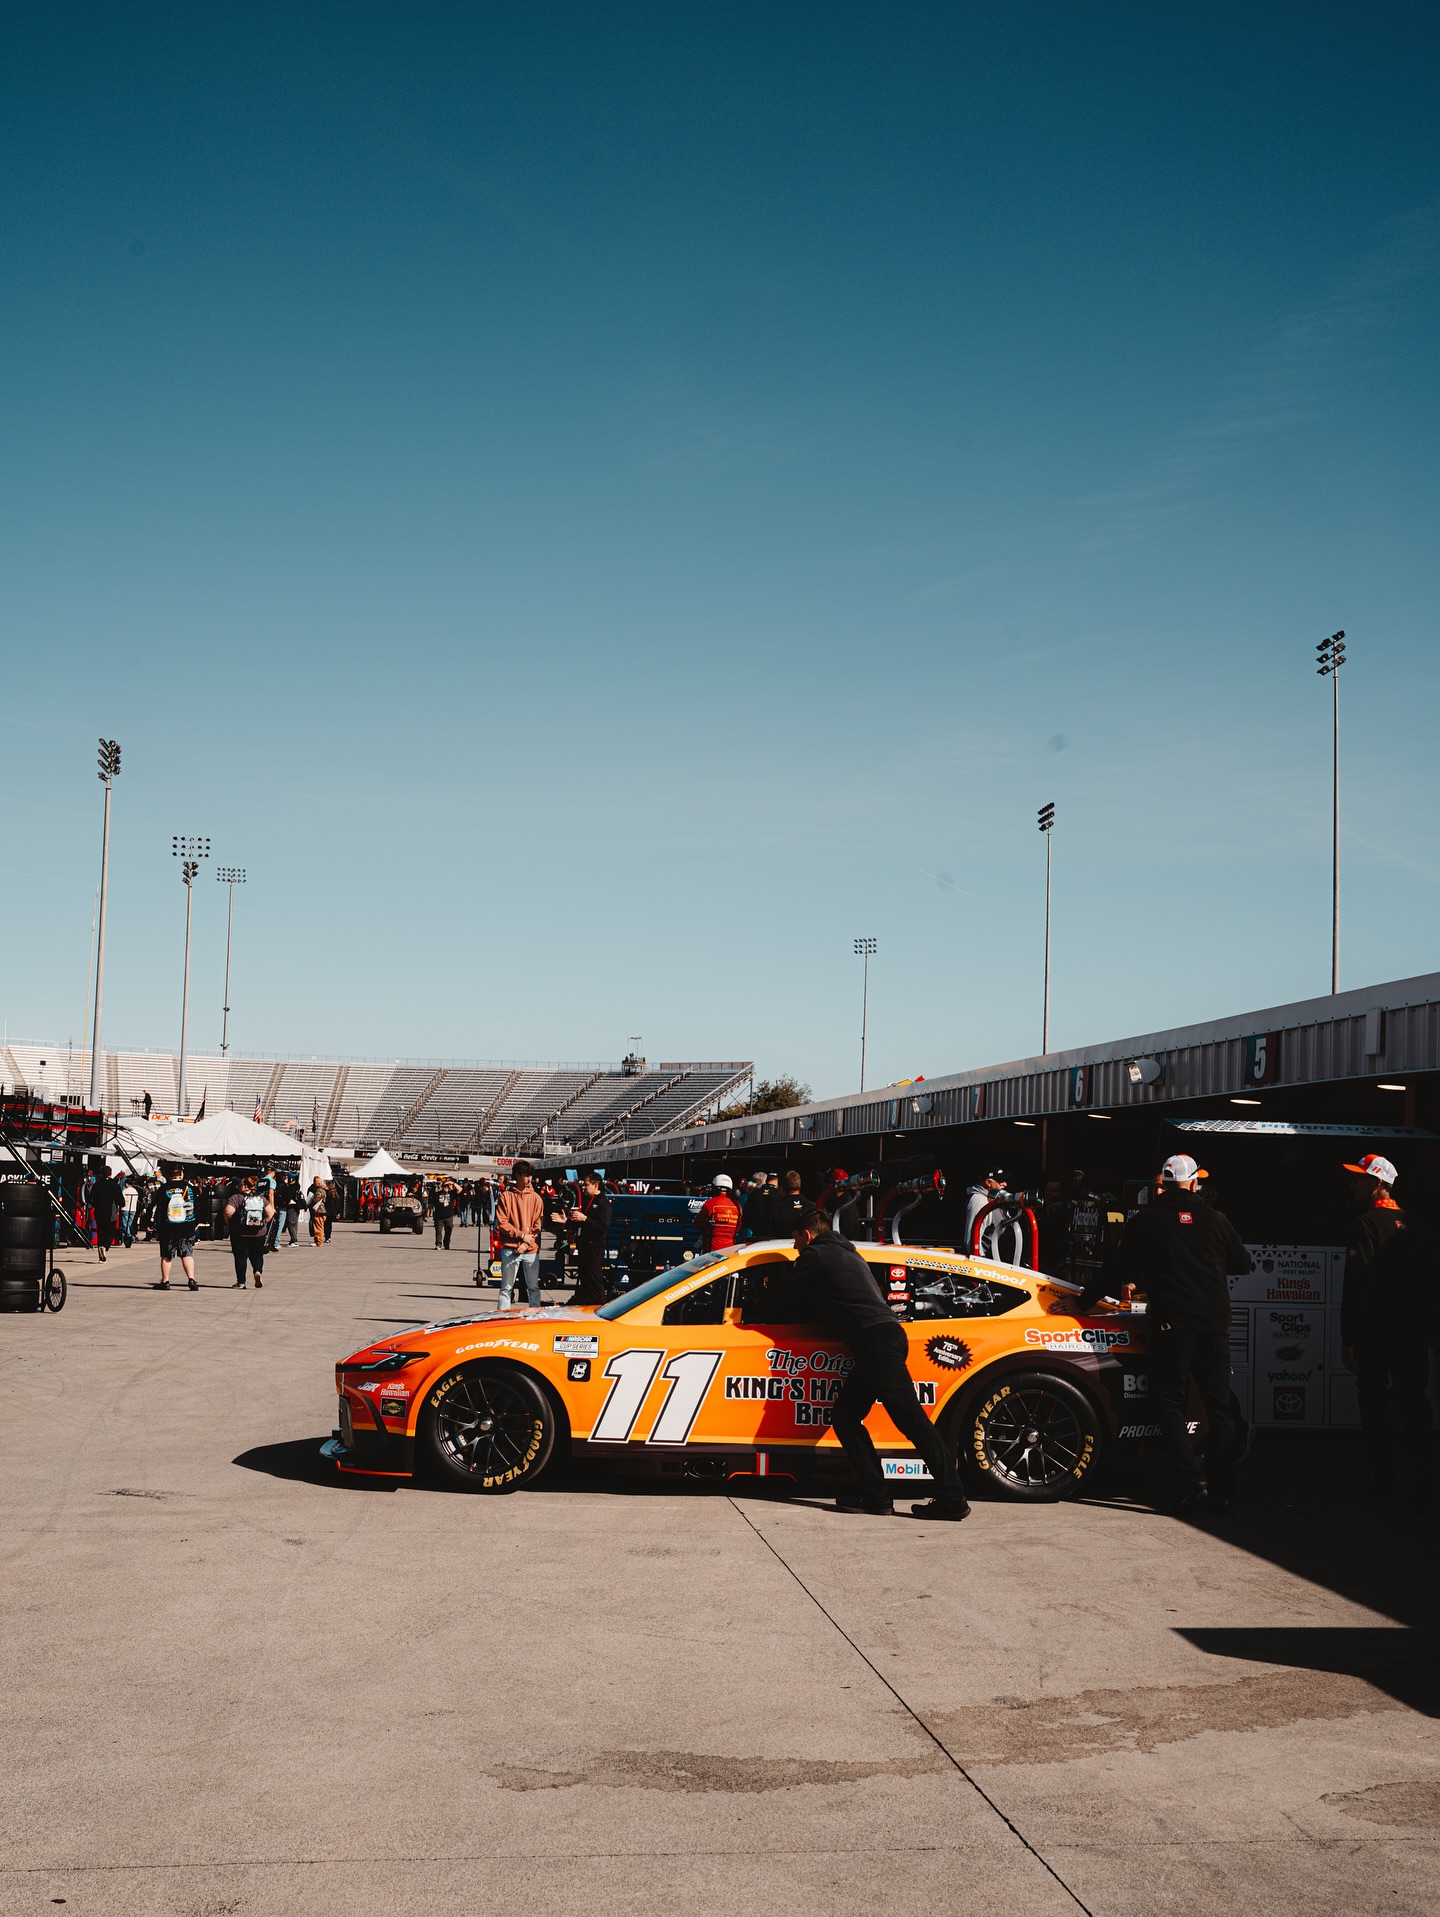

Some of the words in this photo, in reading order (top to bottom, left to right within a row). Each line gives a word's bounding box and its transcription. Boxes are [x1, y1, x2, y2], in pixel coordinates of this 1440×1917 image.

[1253, 1037, 1267, 1080] 5
[1074, 1069, 1084, 1103] 6
[974, 1086, 981, 1115] 7
[1371, 1166, 1383, 1174] 11
[492, 1264, 502, 1272] NAP
[1277, 1260, 1321, 1269] NATIONAL
[664, 1283, 691, 1302] King's
[688, 1265, 728, 1289] Hawaiian
[974, 1266, 1026, 1286] yahoo!
[1277, 1277, 1310, 1290] King's
[1266, 1288, 1320, 1300] Hawaiian
[1270, 1312, 1304, 1323] Sport
[1281, 1322, 1311, 1334] Clips
[455, 1339, 540, 1355] GOODYEAR
[933, 1346, 963, 1362] Anniversary
[1049, 1343, 1107, 1351] HAIRCUTS
[767, 1349, 807, 1375] The
[809, 1351, 855, 1376] Orig
[937, 1354, 955, 1365] Edition
[1267, 1370, 1312, 1383] yahoo!
[357, 1382, 380, 1392] JGR
[430, 1371, 464, 1408] EAGLE
[725, 1376, 804, 1400] KING'S
[587, 1348, 726, 1446] 11
[795, 1402, 833, 1426] Bre
[974, 1386, 1012, 1470] GOODYEAR
[483, 1419, 543, 1487] GOODYEAR
[1073, 1434, 1094, 1479] EAGLE
[885, 1463, 920, 1475] Mobil
